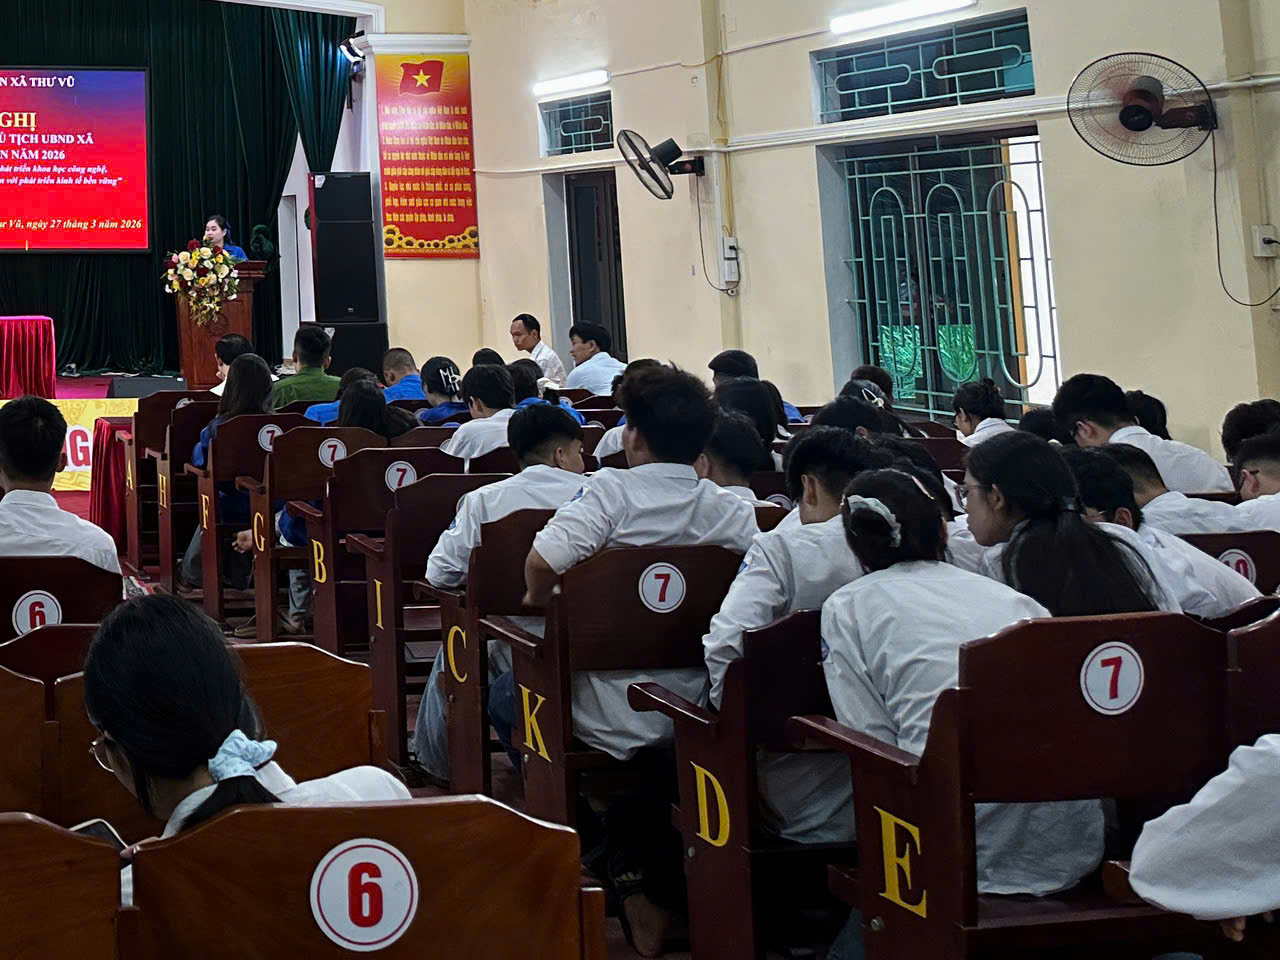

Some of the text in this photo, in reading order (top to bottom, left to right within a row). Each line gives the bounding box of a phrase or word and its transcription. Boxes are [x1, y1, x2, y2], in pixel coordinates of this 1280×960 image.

[10, 74, 27, 87] XÃ
[29, 76, 57, 87] THƯ
[10, 134, 40, 146] TỊCH
[41, 134, 75, 144] UBND
[76, 132, 94, 144] XÃ
[11, 148, 39, 160] NĂM
[41, 149, 66, 160] 2026
[26, 219, 48, 230] ngày
[50, 219, 62, 229] 27
[63, 218, 89, 231] tháng
[91, 219, 97, 229] 3
[98, 220, 118, 229] năm
[120, 219, 142, 229] 2026
[266, 430, 276, 446] 7
[328, 444, 337, 462] 7
[126, 459, 134, 490] A
[159, 473, 167, 509] H
[396, 467, 407, 487] 7
[200, 492, 210, 530] F
[253, 512, 266, 552] G
[310, 539, 327, 583] B
[654, 573, 671, 603] 7
[28, 600, 46, 629] 6
[447, 625, 468, 683] C
[1100, 656, 1123, 700] 7
[519, 683, 552, 762] K
[689, 761, 730, 847] D
[872, 806, 927, 919] E
[347, 861, 383, 928] 6
